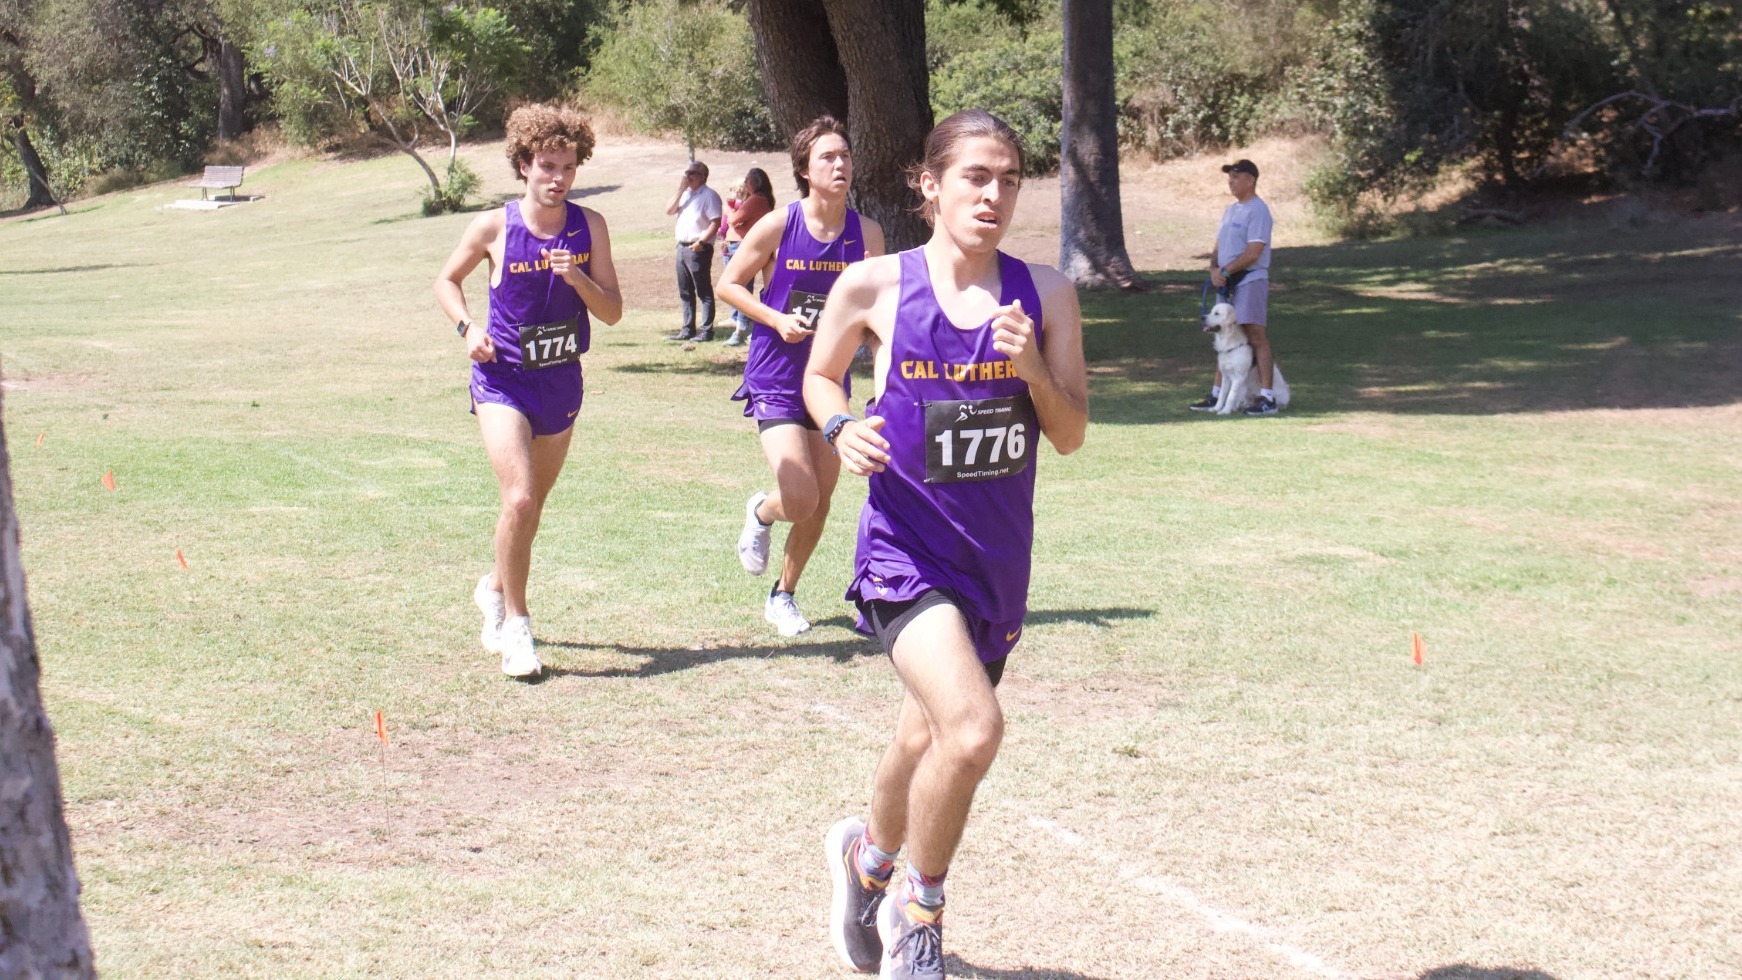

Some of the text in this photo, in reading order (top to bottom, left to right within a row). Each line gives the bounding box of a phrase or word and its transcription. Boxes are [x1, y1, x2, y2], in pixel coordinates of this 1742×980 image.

[509, 252, 590, 274] CAL LURAN
[786, 259, 806, 271] CAL
[525, 333, 577, 361] 1774
[901, 360, 939, 379] CAL
[935, 423, 1026, 466] 1776
[956, 467, 1009, 479] SpeedTiming.net
